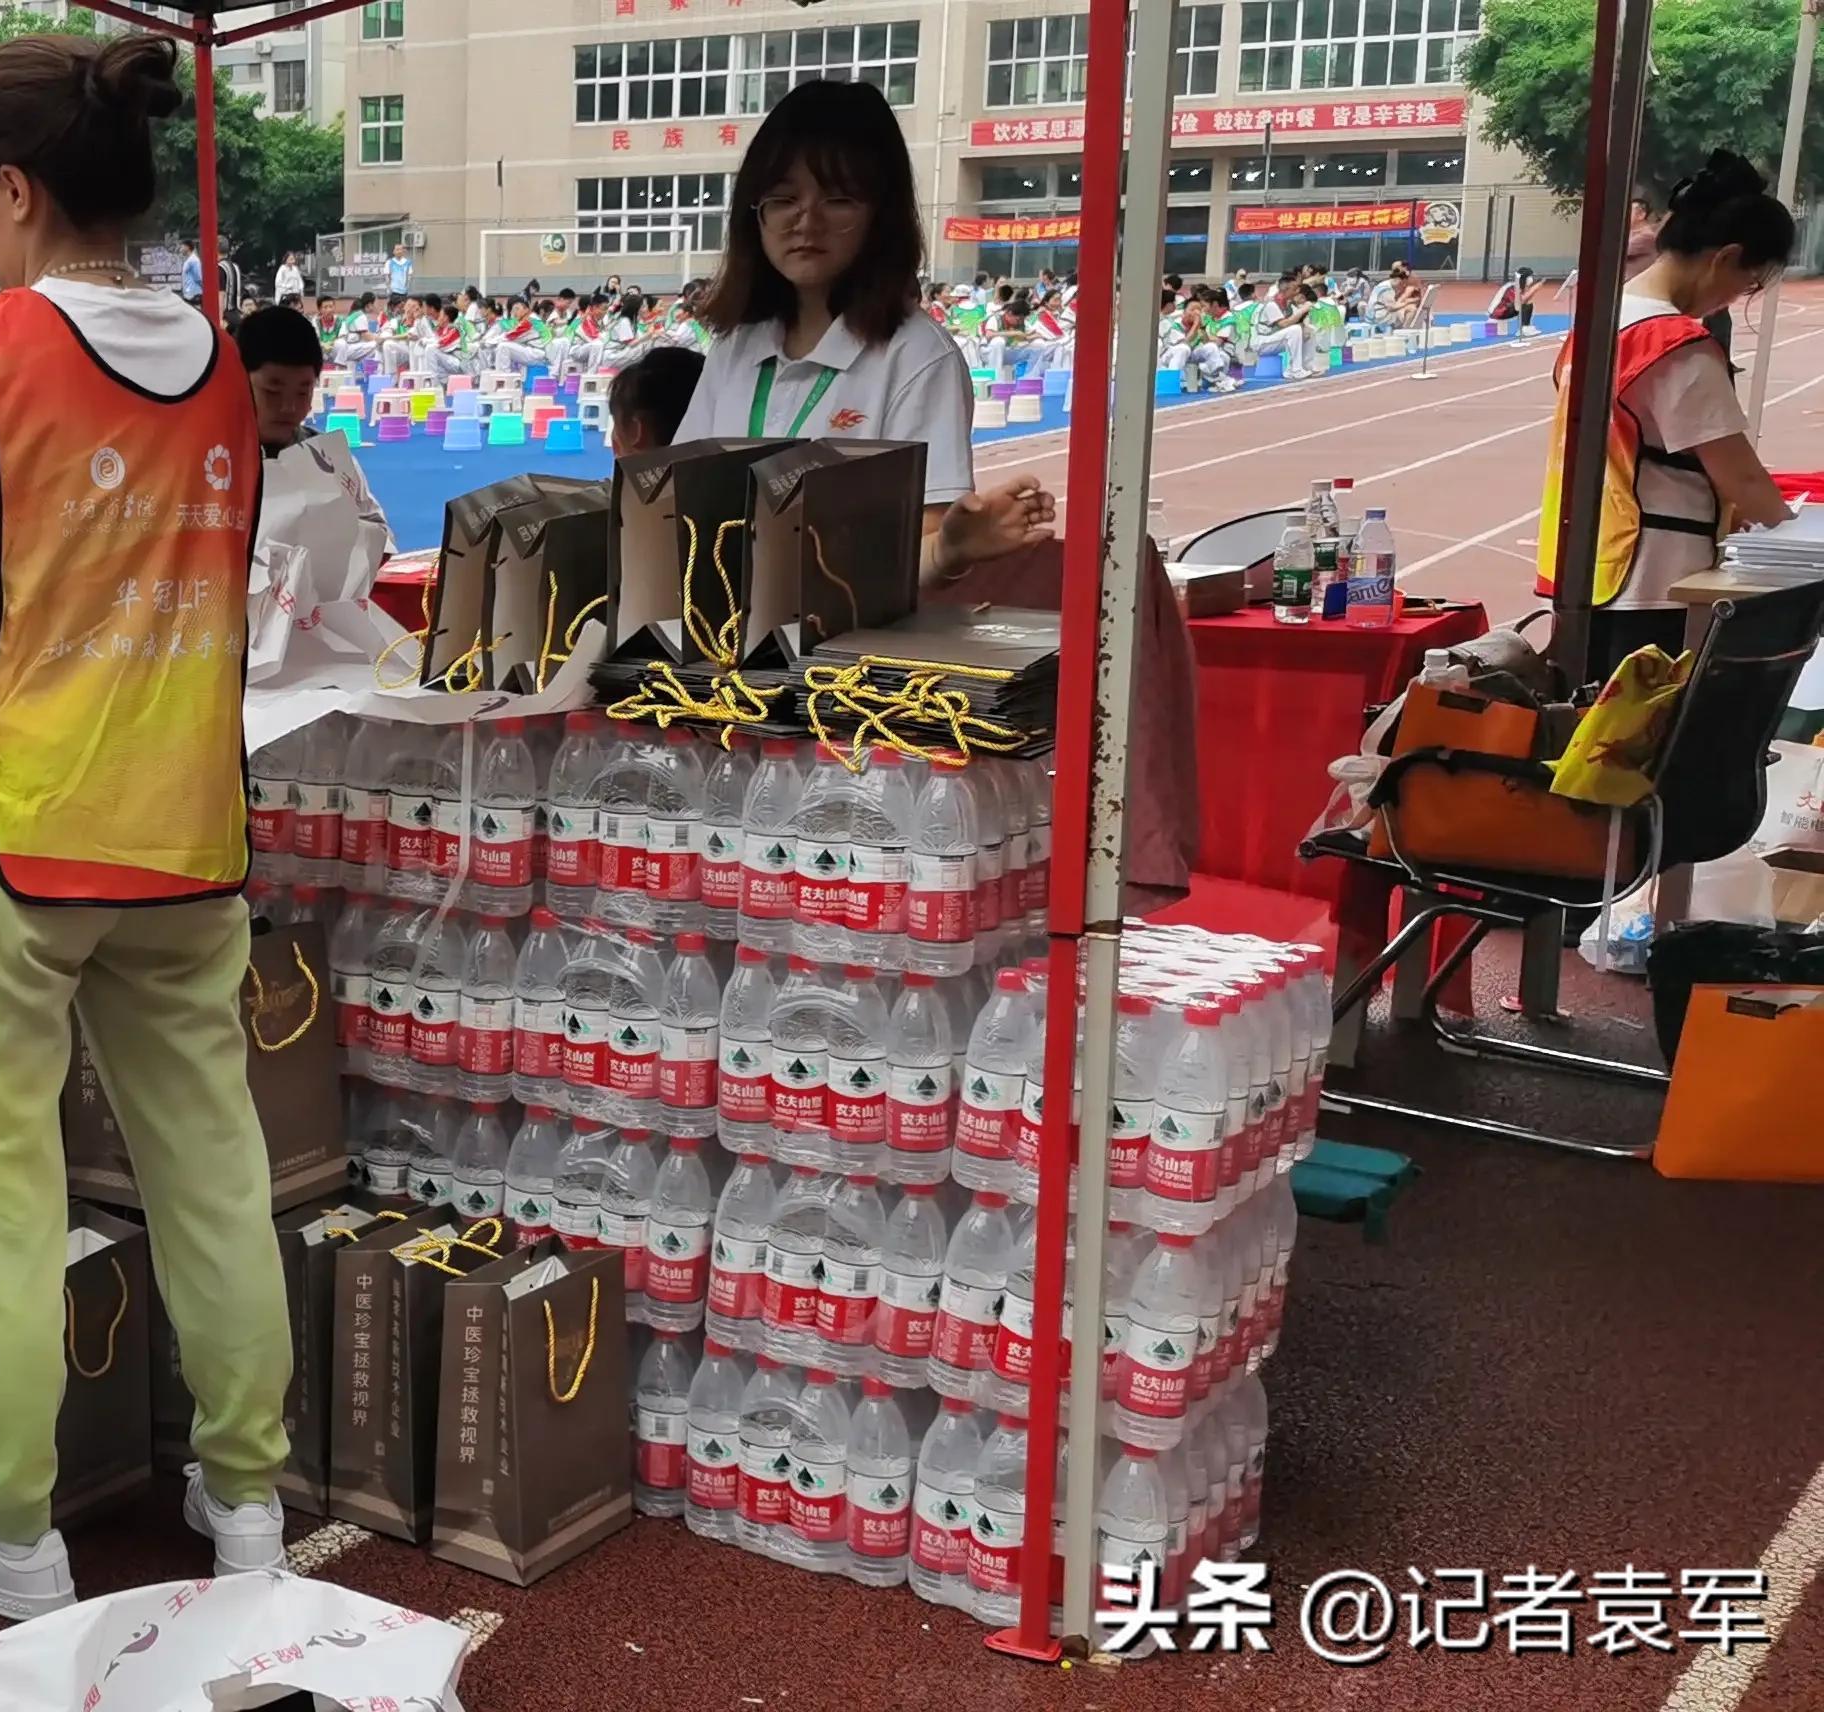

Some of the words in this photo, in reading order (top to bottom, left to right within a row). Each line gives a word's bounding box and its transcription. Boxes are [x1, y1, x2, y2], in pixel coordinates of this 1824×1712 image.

[775, 1092, 824, 1111] 农夫山泉
[351, 1272, 374, 1428] 中医珍宝拯救视界
[458, 1304, 484, 1465] 中医珍宝拯救视界
